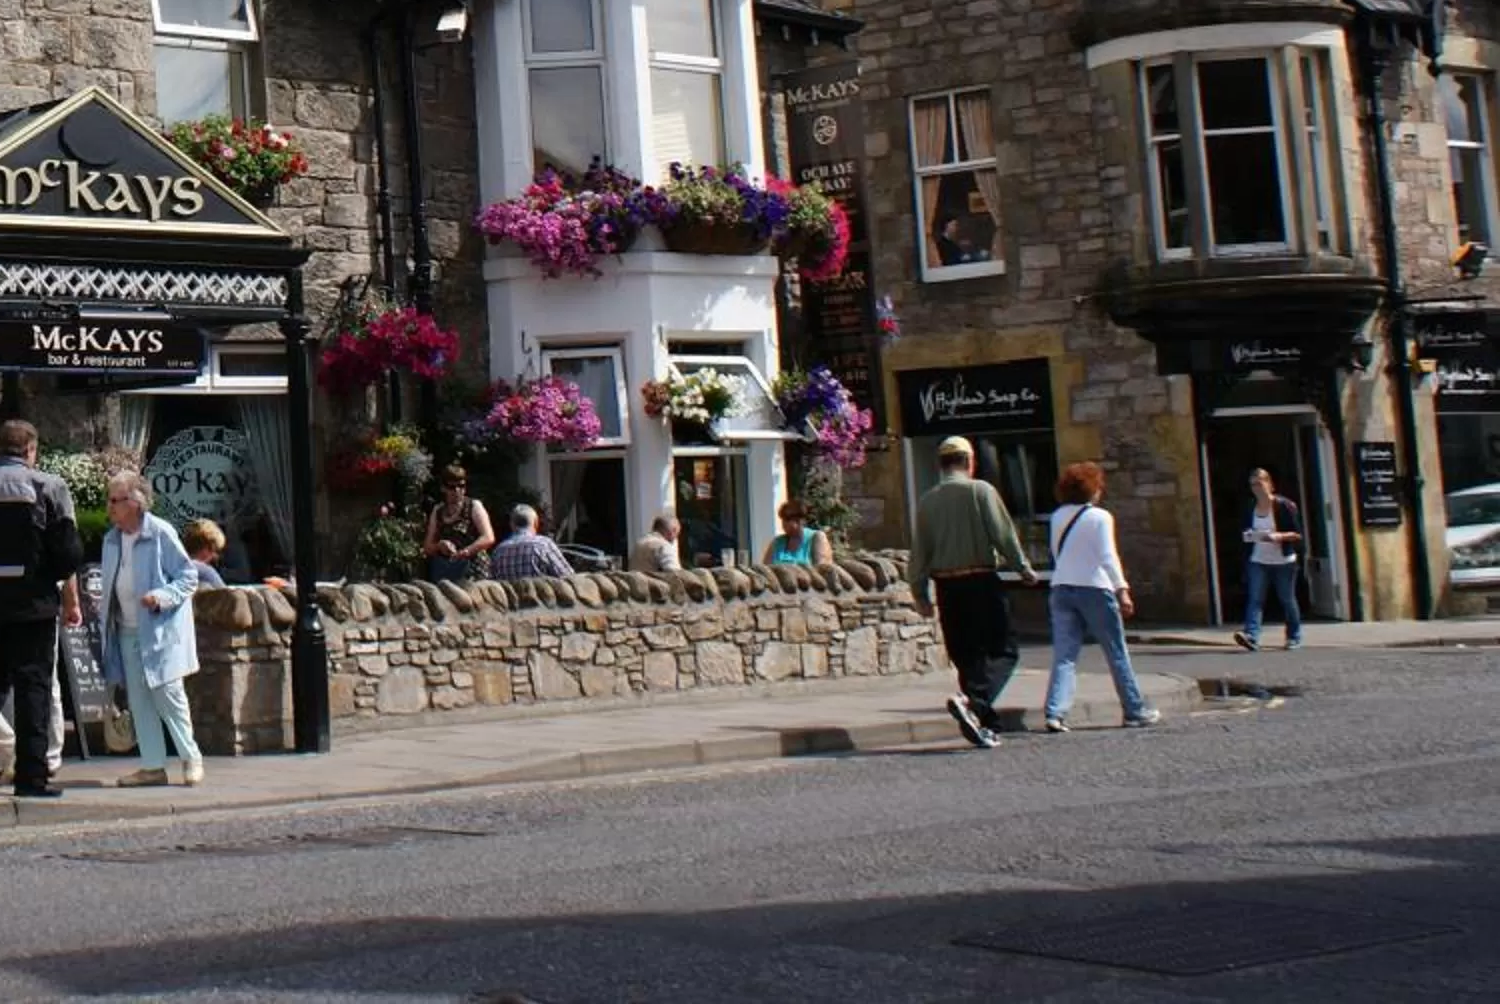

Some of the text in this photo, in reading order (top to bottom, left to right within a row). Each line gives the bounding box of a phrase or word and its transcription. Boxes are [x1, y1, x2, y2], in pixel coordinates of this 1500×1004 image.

[32, 325, 163, 352] McKAYS
[47, 353, 146, 367] bar & restaurant
